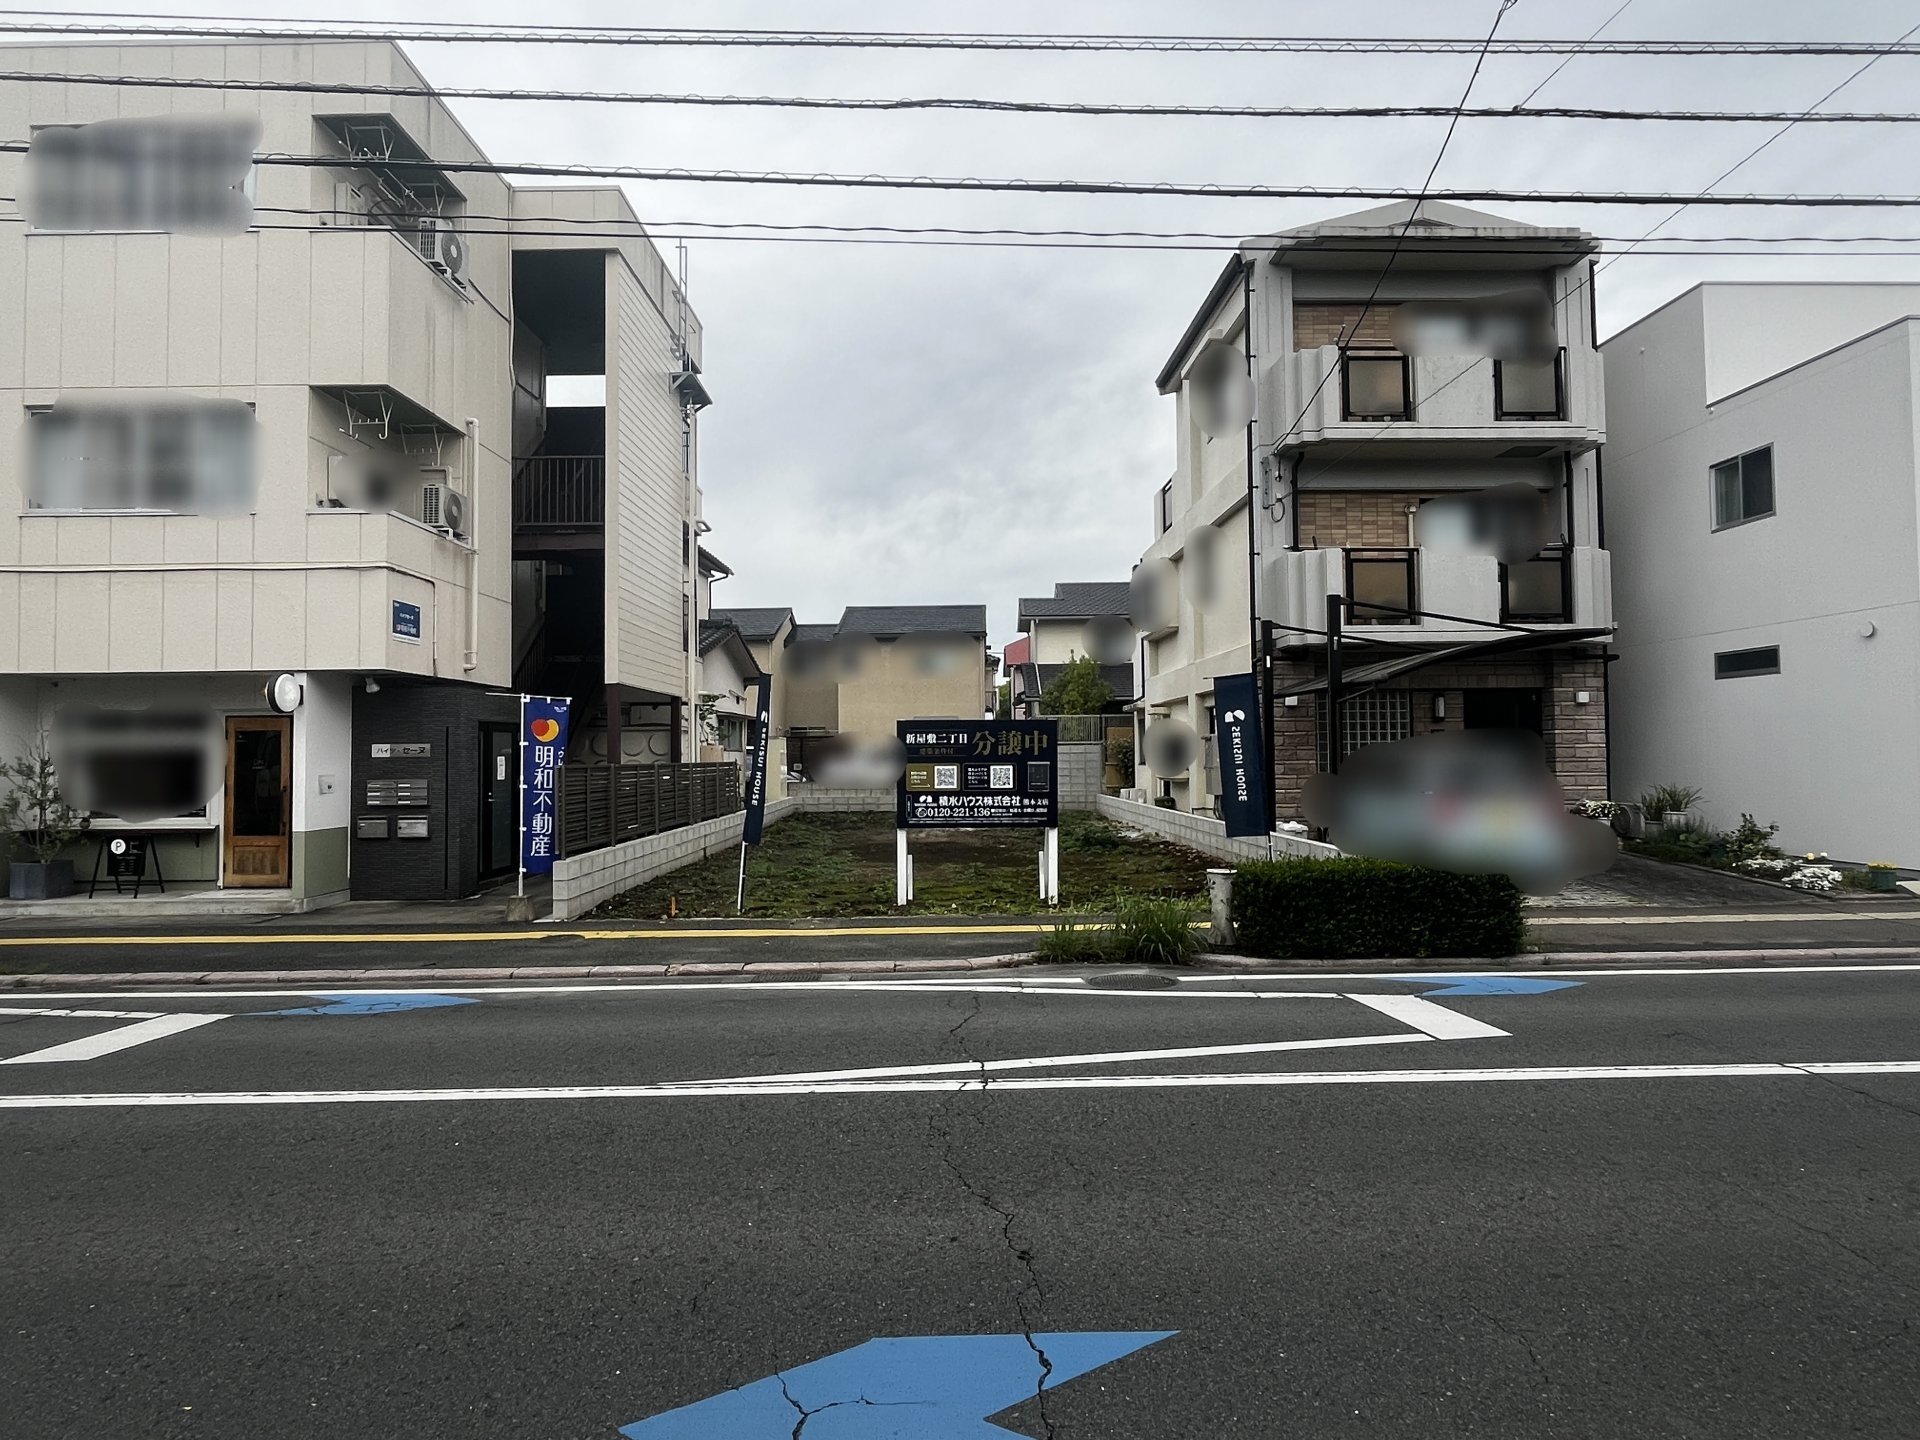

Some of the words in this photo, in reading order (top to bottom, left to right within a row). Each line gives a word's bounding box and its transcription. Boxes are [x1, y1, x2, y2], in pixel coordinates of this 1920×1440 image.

[757, 727, 767, 767] SEKISUI
[905, 733, 968, 744] 新屋敷二丁目
[972, 730, 1049, 756] 分譲中
[530, 745, 554, 857] 明和不動産
[751, 771, 762, 806] HOUSE
[939, 795, 1021, 807] 積水ハウス株式会社
[927, 807, 991, 817] 0120-221-136
